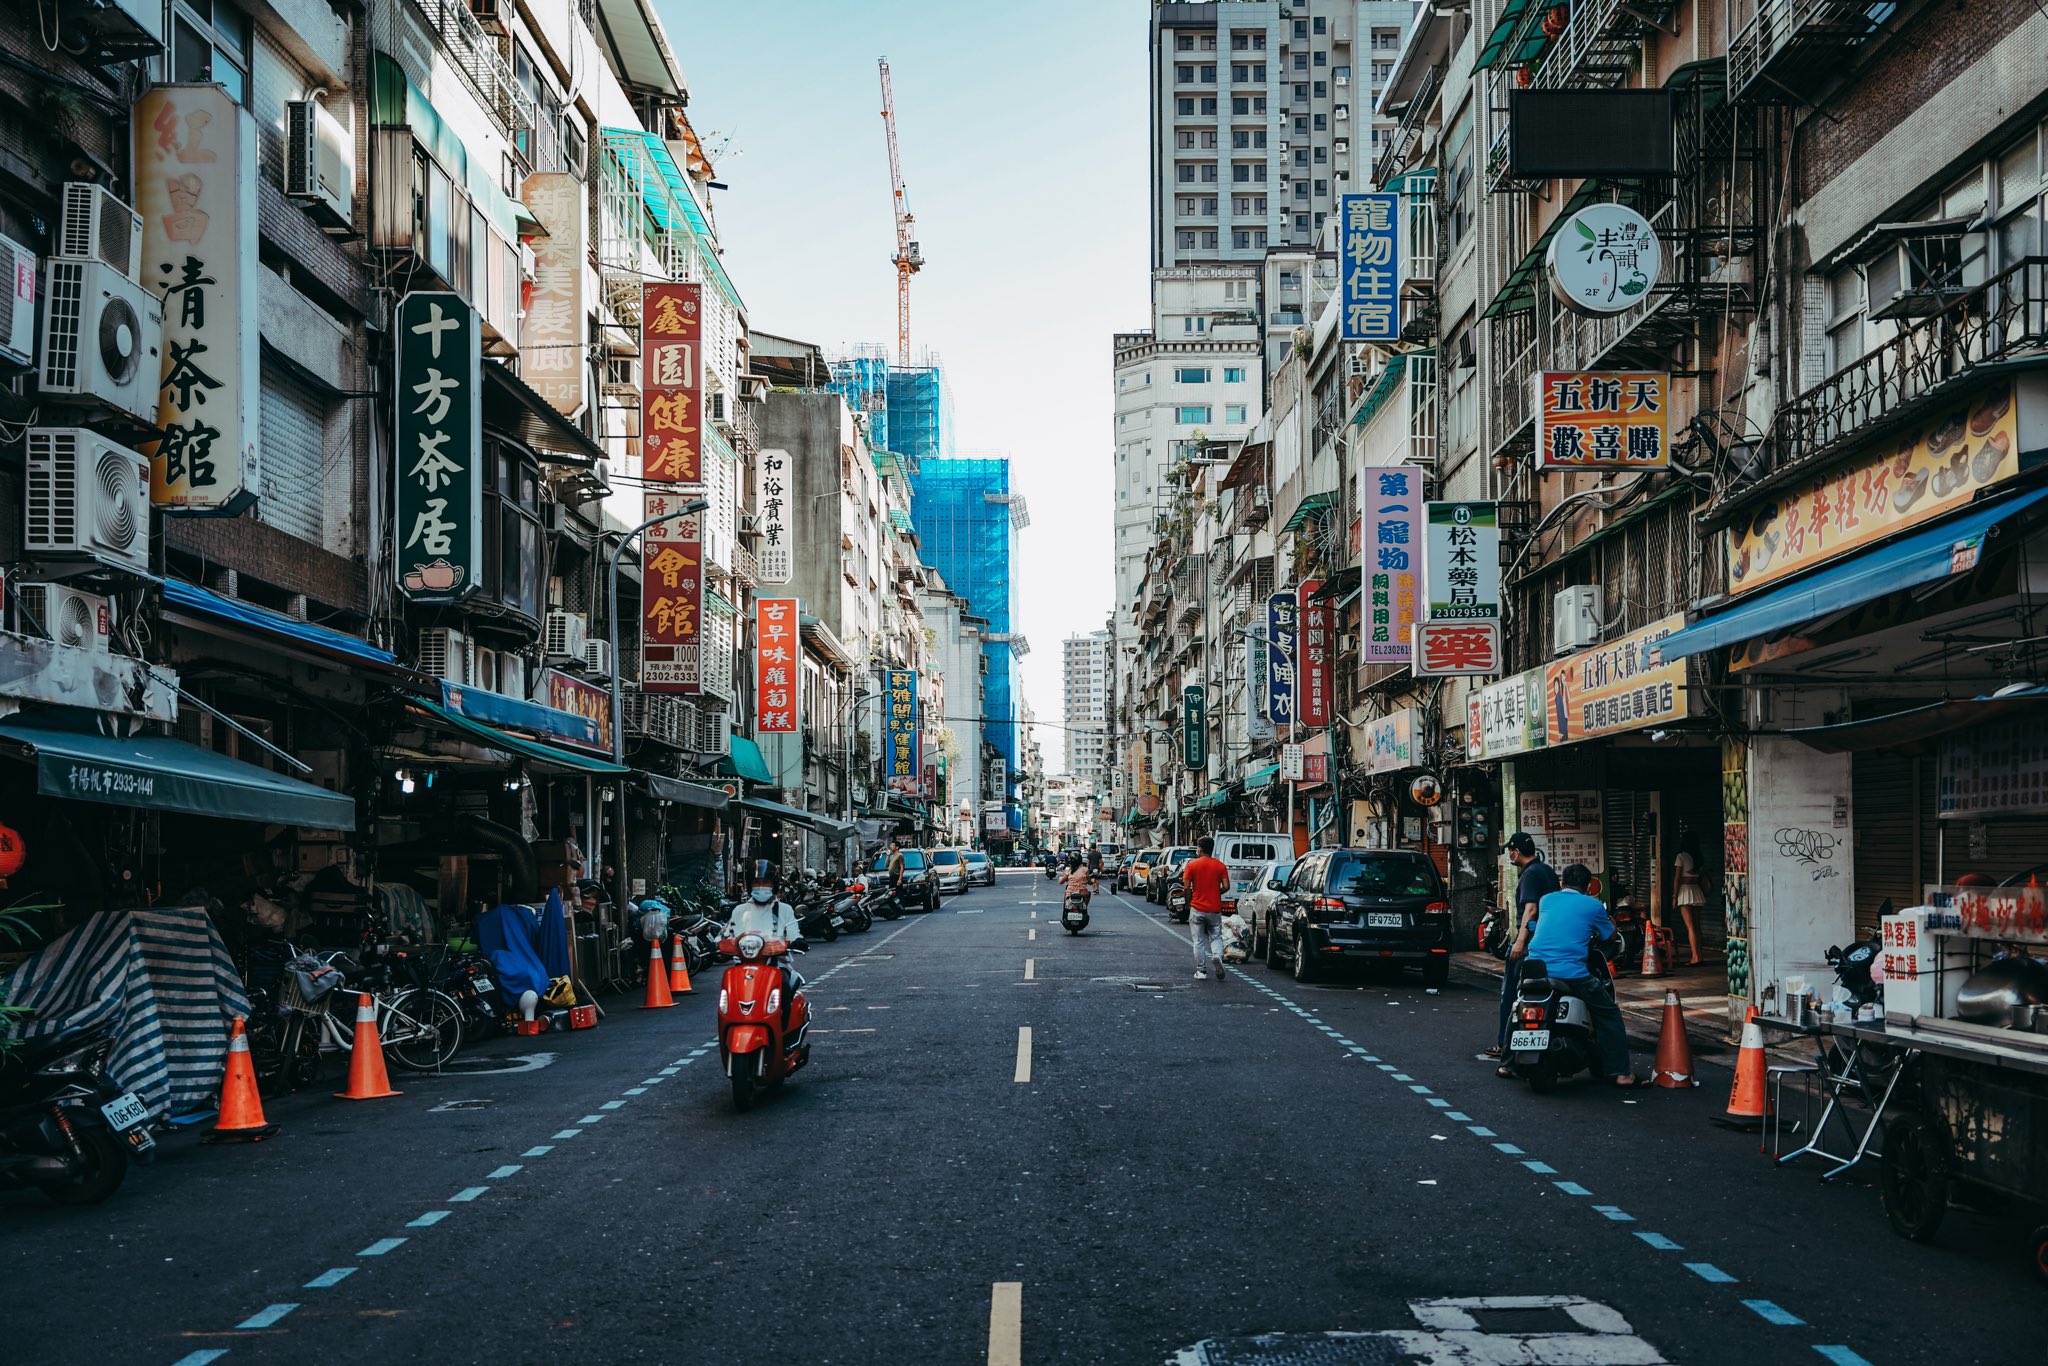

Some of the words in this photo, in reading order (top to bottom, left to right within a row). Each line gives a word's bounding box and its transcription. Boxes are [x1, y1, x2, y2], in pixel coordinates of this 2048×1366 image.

[1347, 198, 1392, 335] 寵物住宿
[1585, 289, 1600, 297] 2F
[647, 295, 697, 479] 鑫園健康
[1552, 380, 1660, 413] 五折天
[405, 303, 464, 556] 十方茶居
[1552, 426, 1660, 460] 歡喜購
[763, 456, 784, 546] 和裕實業
[1378, 473, 1409, 570] 第一寵物
[1781, 466, 1890, 559] 萬華鞋坊
[1448, 526, 1478, 607] 松本藥局
[648, 547, 697, 637] 會館
[1372, 573, 1390, 642] 飼料用品
[1436, 608, 1491, 618] 23029559
[676, 646, 697, 662] 1000
[1272, 601, 1293, 717] 宜昌睡衣
[1425, 627, 1493, 669] 藥
[646, 671, 698, 681] 2302-6333
[1470, 700, 1480, 749] 藥
[1483, 683, 1527, 735] 松本藥局
[1583, 681, 1673, 731] 即期商品專賣店
[113, 772, 153, 796] 2933-1441
[1548, 797, 1576, 828] 藥
[1884, 920, 1917, 948] 熟客湯
[1885, 954, 1918, 982] 豬血湯
[1512, 1035, 1547, 1048] 966-KTG
[109, 1102, 144, 1127] 106-KBD
